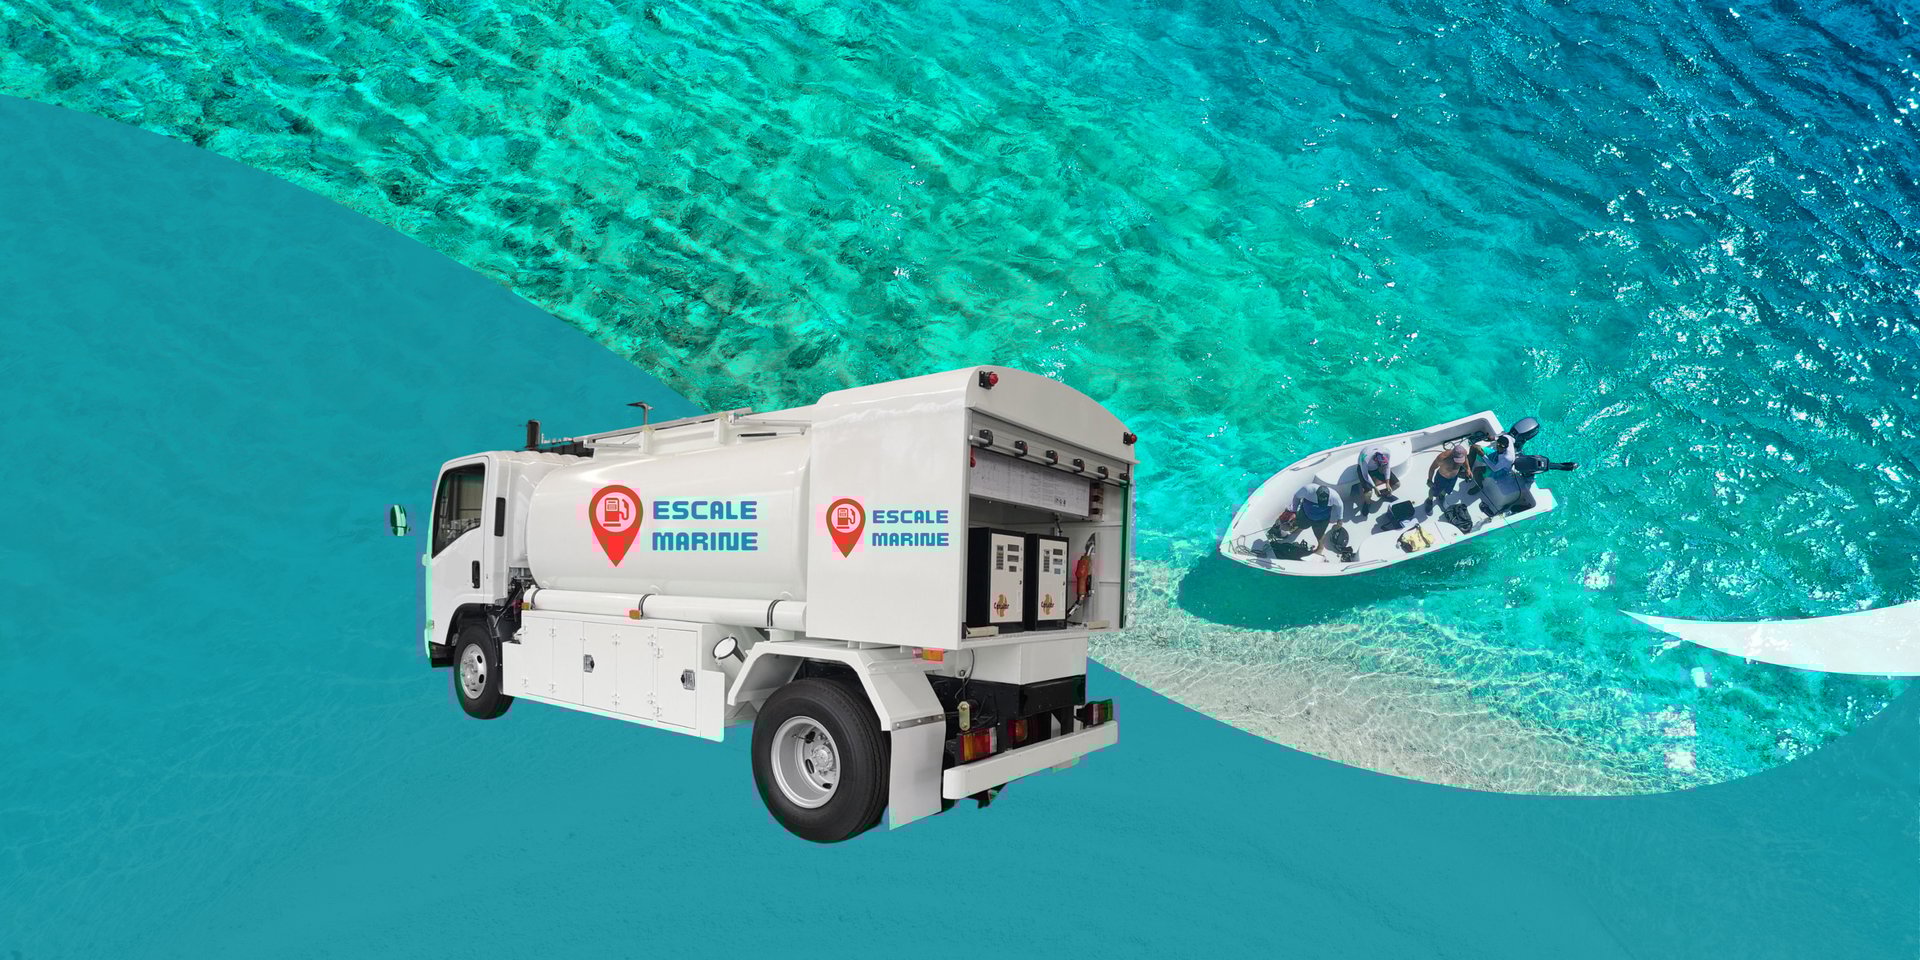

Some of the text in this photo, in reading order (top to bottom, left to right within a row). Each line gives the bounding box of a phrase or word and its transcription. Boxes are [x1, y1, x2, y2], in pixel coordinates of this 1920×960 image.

[653, 501, 757, 520] ESCALE
[872, 509, 949, 524] ESCALE
[652, 532, 758, 551] MARINE
[871, 532, 949, 547] MARINE
